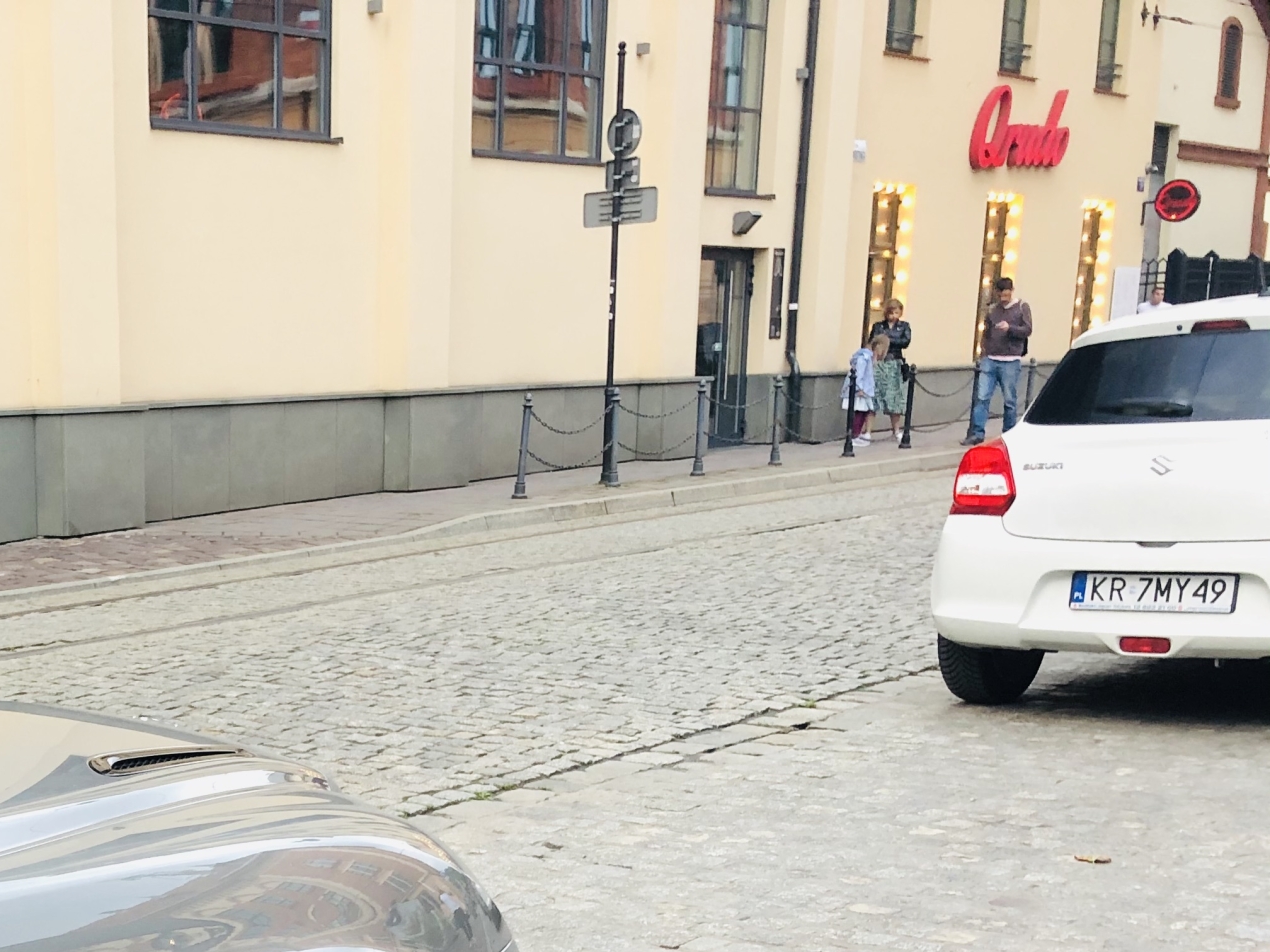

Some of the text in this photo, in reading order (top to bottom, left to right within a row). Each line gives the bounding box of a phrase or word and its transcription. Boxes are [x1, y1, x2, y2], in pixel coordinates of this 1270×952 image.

[1022, 462, 1064, 471] SUZUKI
[1090, 576, 1227, 604] KR 7MY49
[1073, 592, 1084, 600] PL
